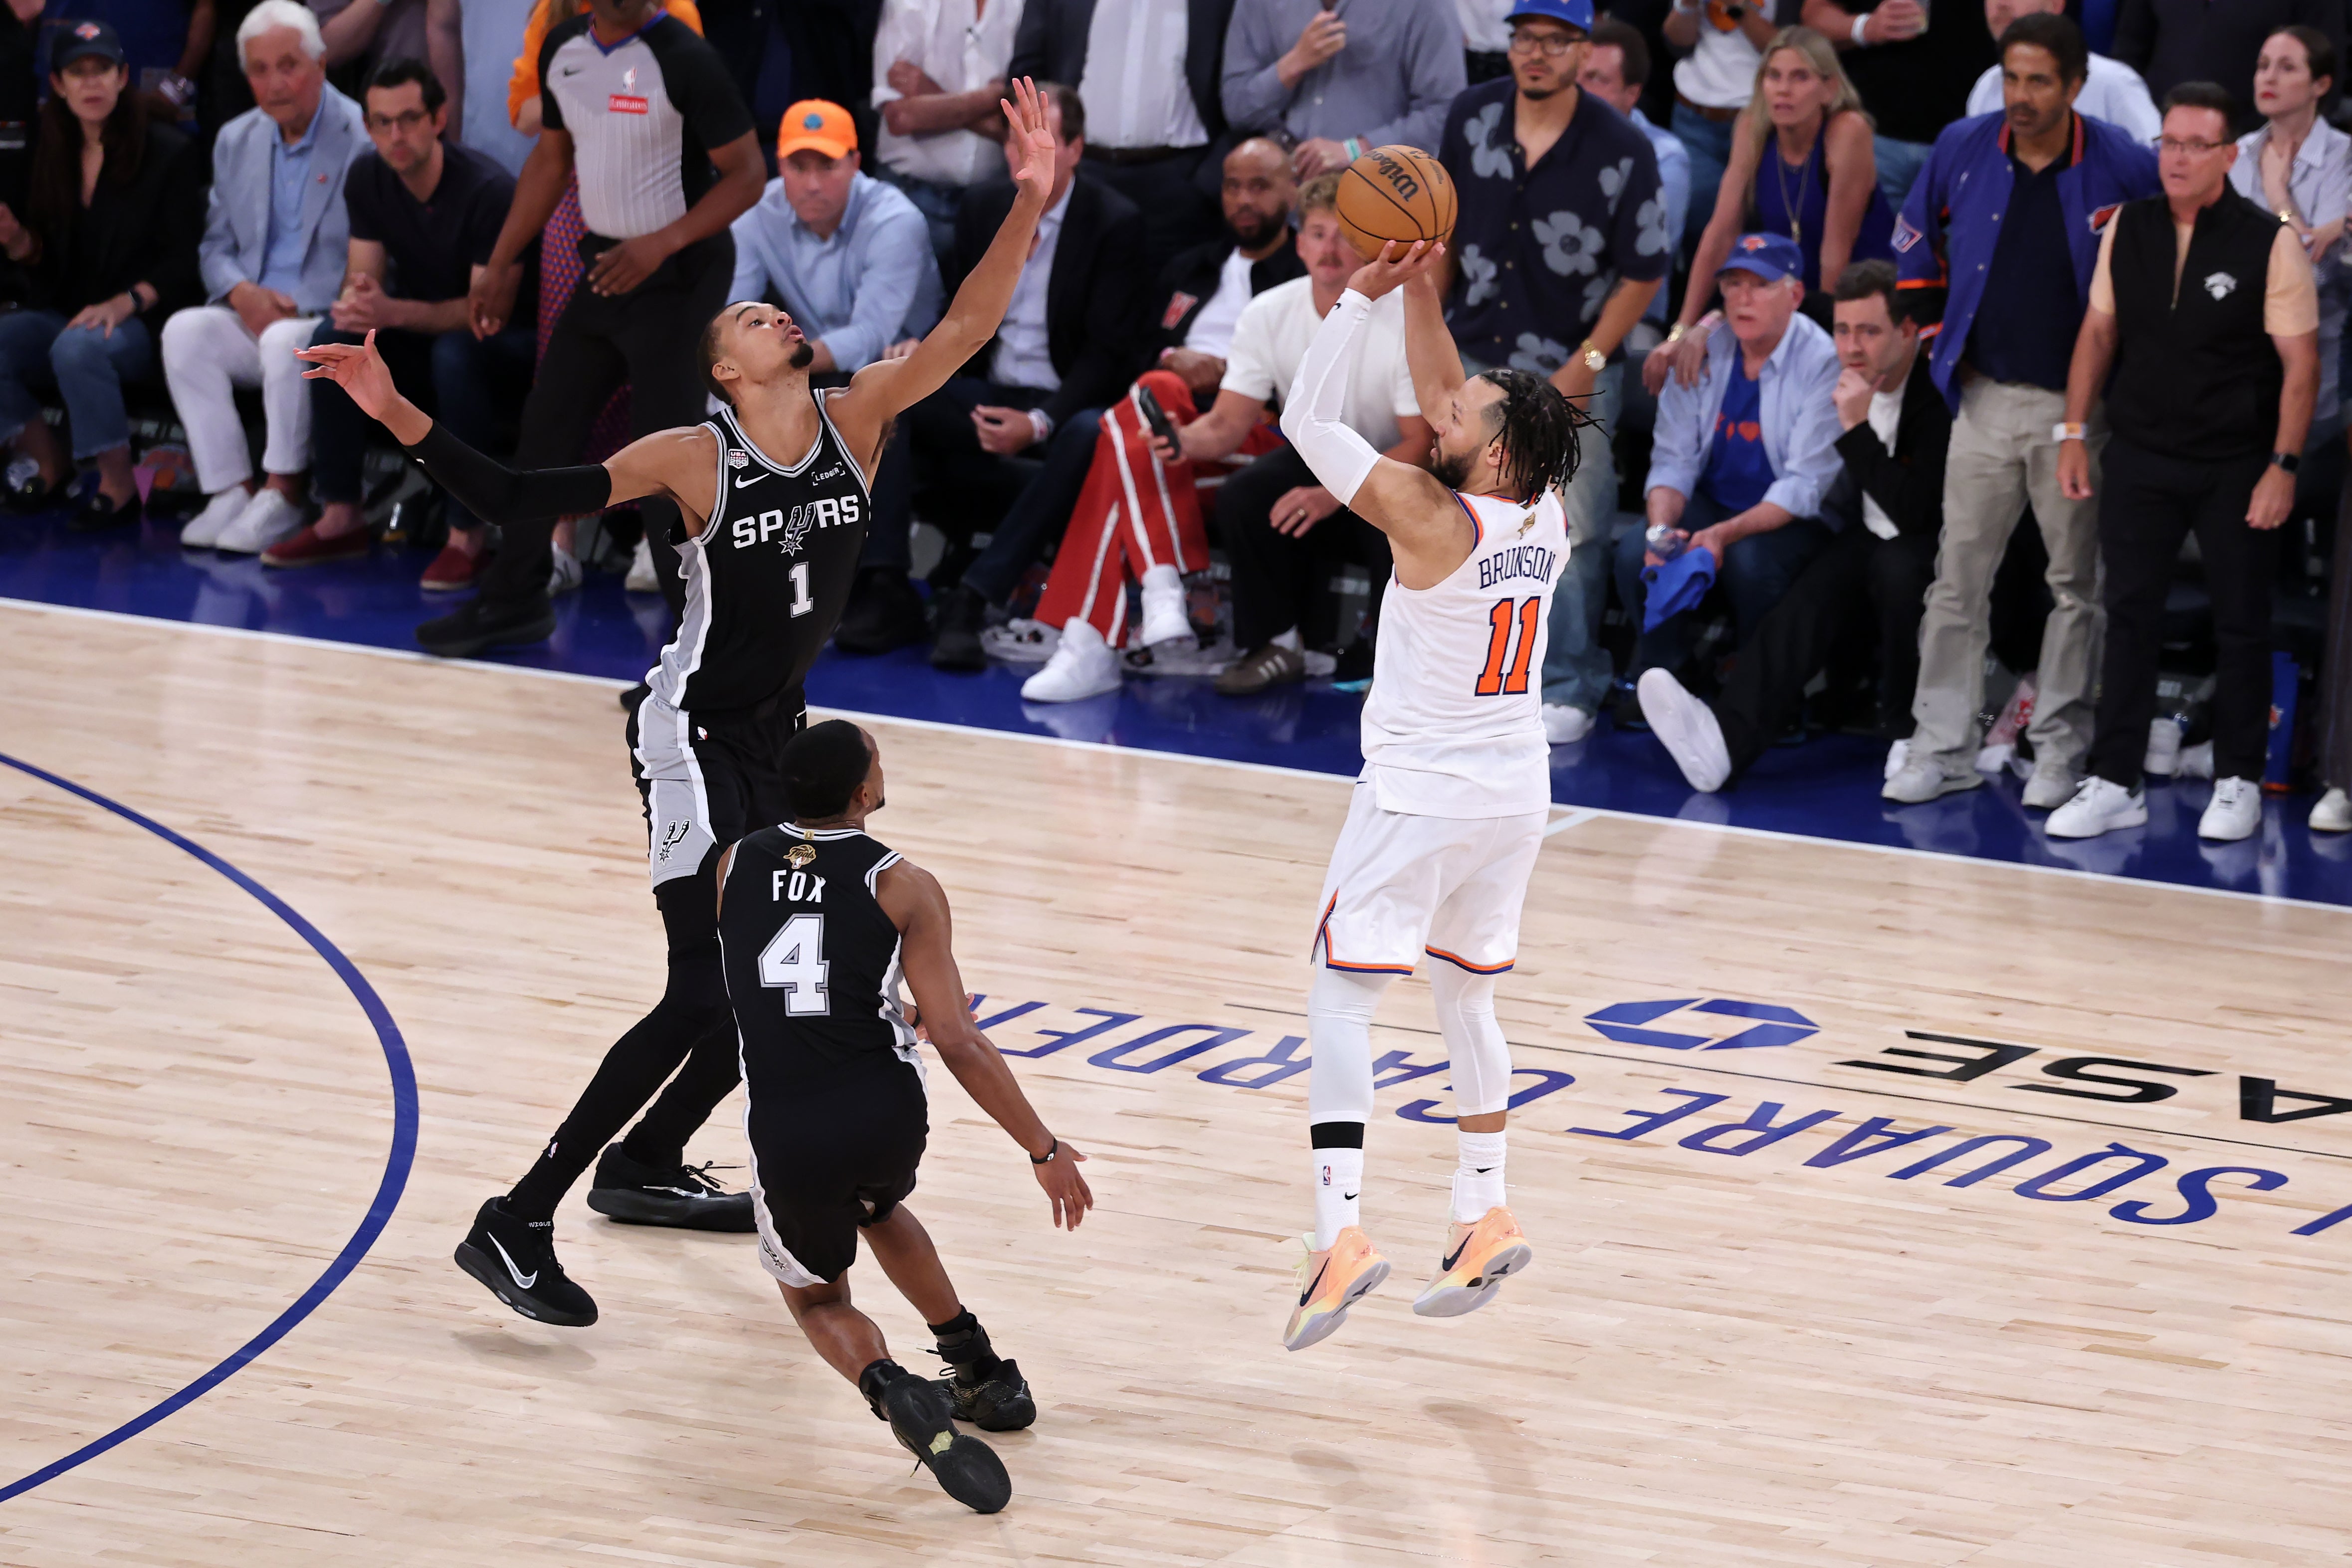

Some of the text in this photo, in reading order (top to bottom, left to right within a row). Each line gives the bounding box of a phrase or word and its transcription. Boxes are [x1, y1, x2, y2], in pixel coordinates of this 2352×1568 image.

[815, 467, 840, 481] LEDGER
[732, 494, 859, 557] SPURS
[788, 561, 814, 618] 1
[1478, 546, 1557, 590] BRUNSON
[1474, 595, 1541, 697] 11
[785, 846, 815, 858] Finals
[773, 869, 827, 904] FOX
[757, 913, 831, 1017] 4
[1564, 1087, 2289, 1225] SQUARE
